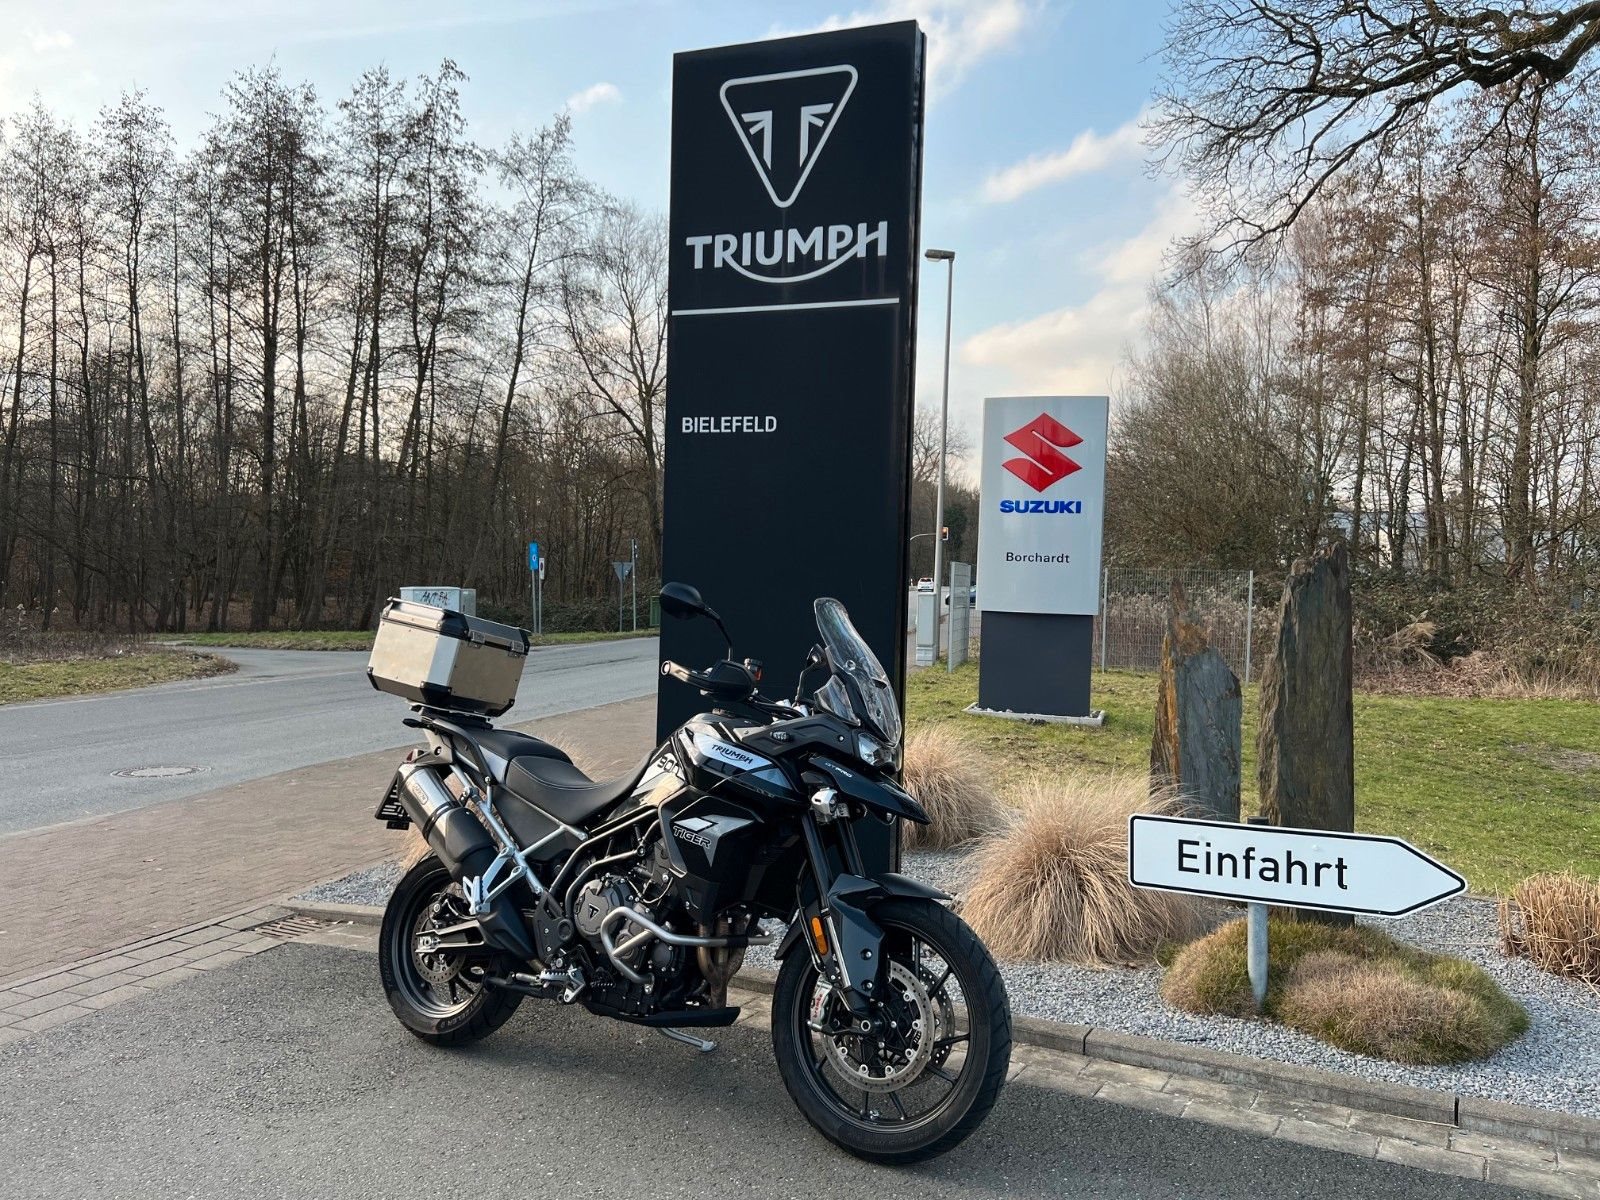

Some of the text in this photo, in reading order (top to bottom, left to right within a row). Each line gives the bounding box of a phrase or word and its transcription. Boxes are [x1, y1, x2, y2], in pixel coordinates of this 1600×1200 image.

[686, 221, 888, 283] TRIUMPH
[682, 415, 777, 433] BIELEFELD
[1000, 499, 1082, 514] SUZUKI
[1005, 551, 1070, 564] Borchardt
[711, 744, 754, 764] TRIUMPH
[673, 825, 712, 849] TIGER
[1177, 838, 1348, 890] Einfahrt
